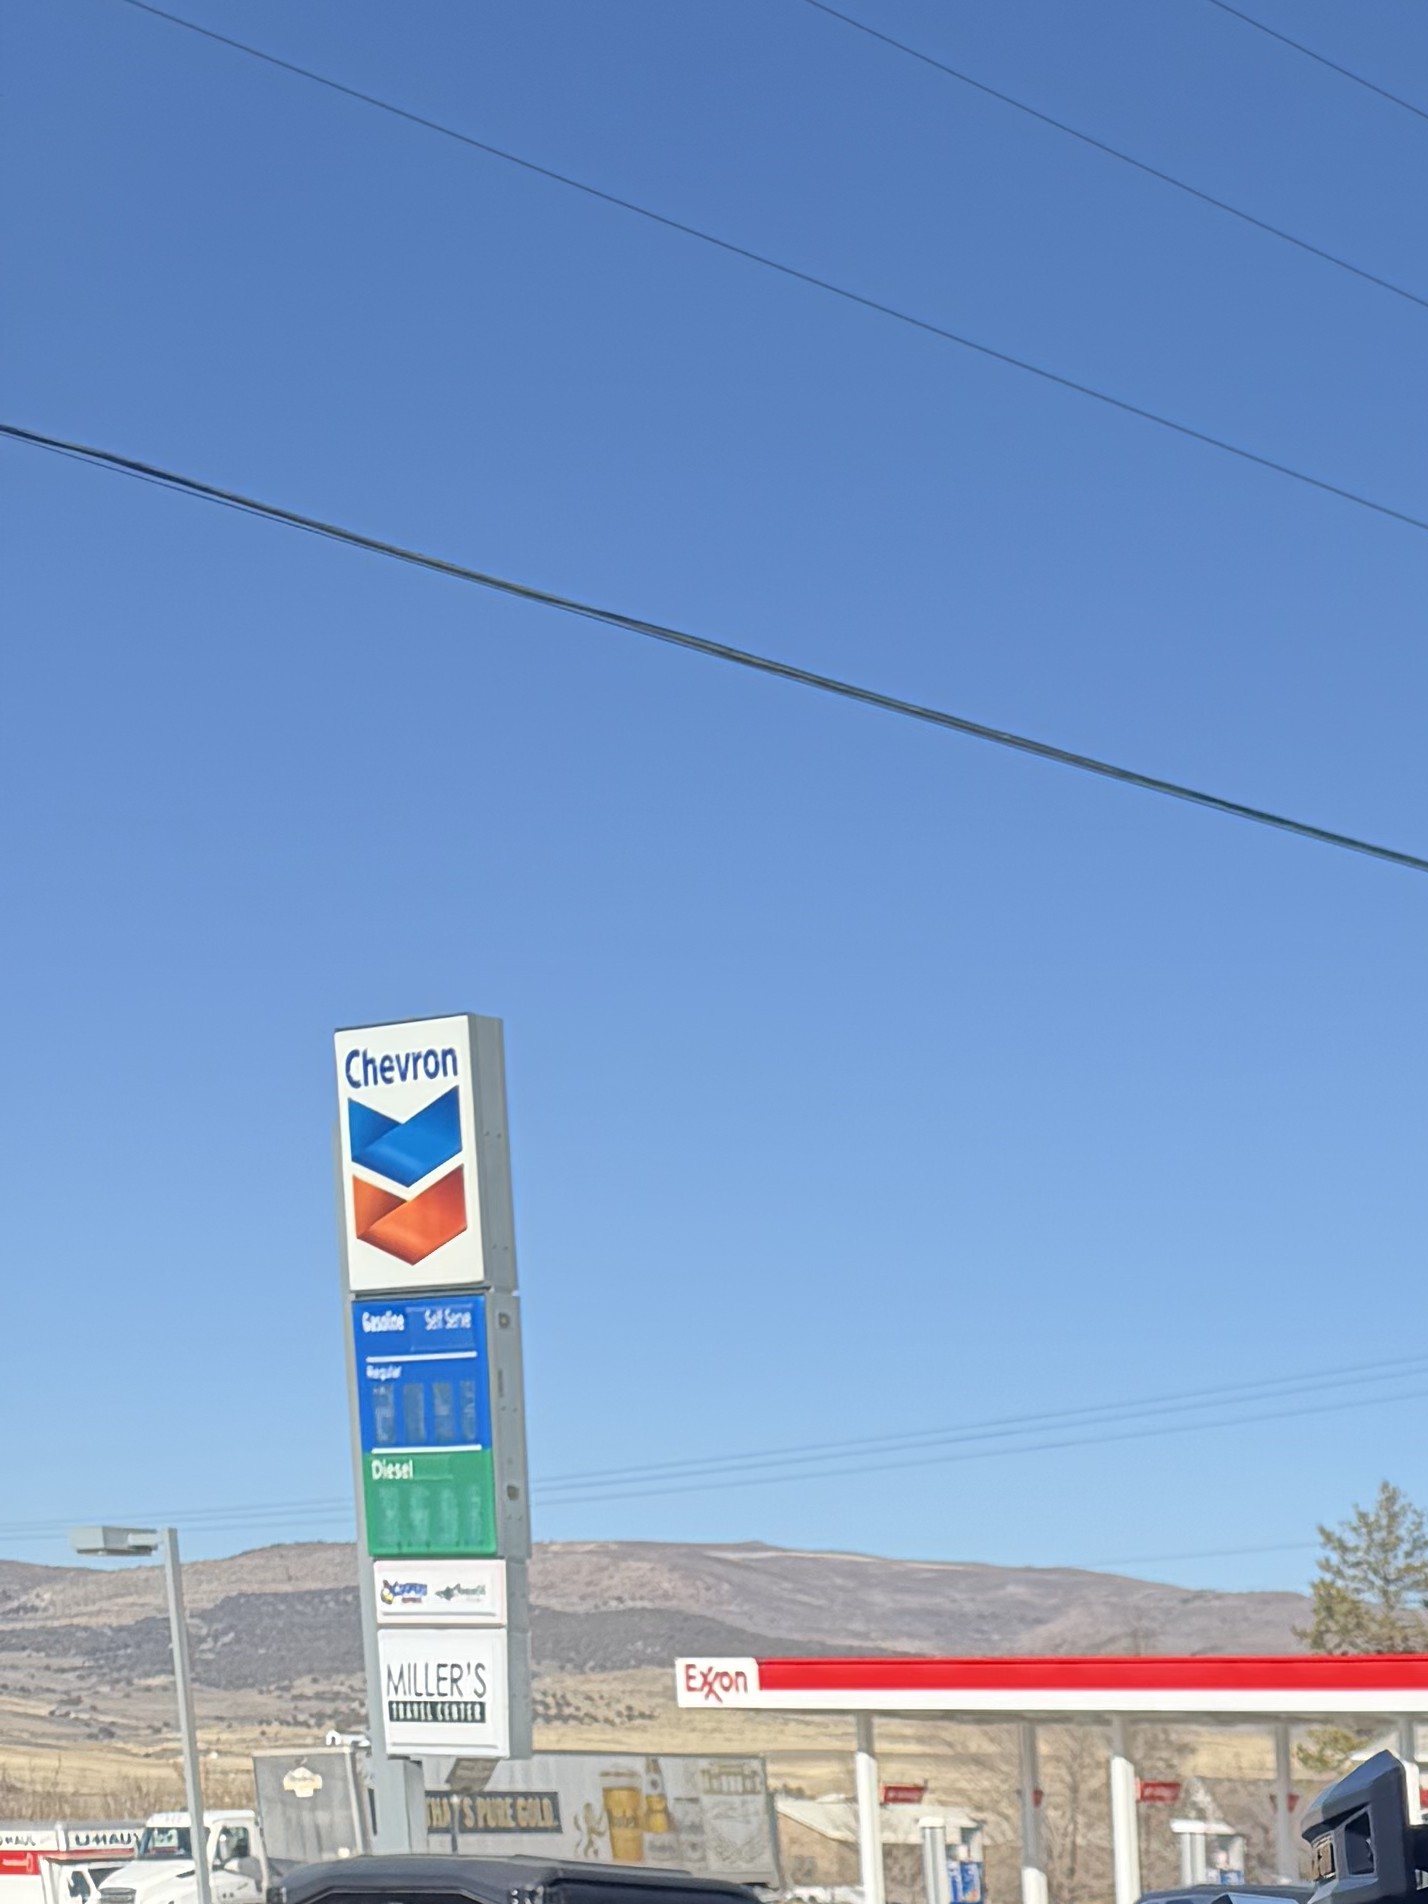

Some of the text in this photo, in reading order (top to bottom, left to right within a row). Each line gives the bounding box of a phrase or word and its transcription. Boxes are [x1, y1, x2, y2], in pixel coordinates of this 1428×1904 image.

[345, 1047, 459, 1089] Chevron
[362, 1309, 472, 1333] Gasoline Self Serve
[371, 1460, 414, 1480] Diesel
[387, 1662, 487, 1698] MILLER'S
[685, 1664, 748, 1702] Exxon
